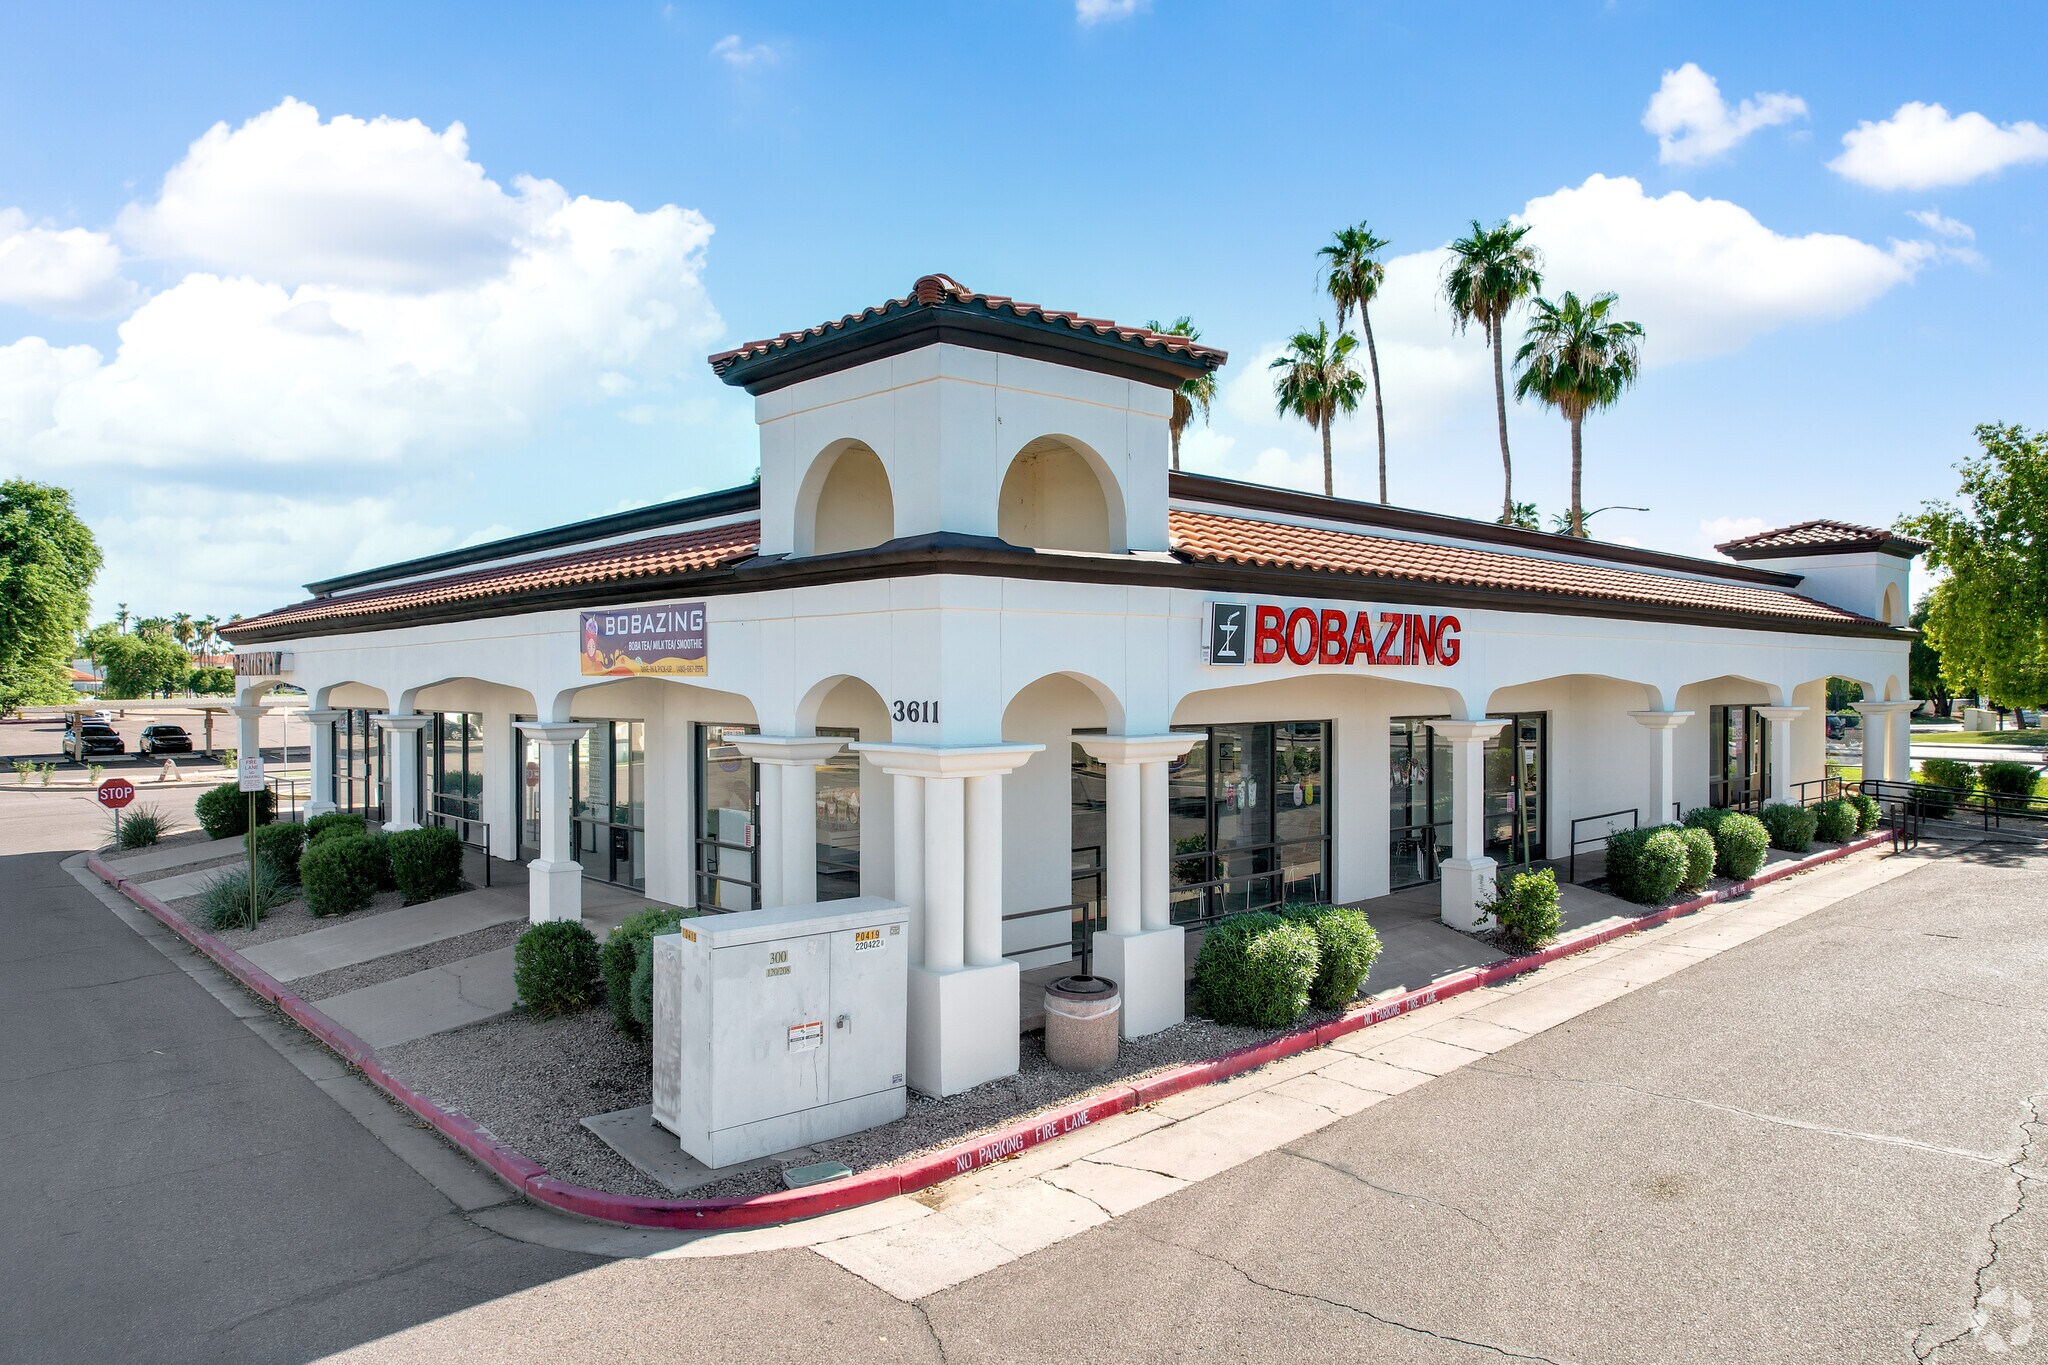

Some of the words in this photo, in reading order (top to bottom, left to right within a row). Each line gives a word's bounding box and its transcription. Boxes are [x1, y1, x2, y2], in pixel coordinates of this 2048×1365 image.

[605, 610, 703, 636] BOBAZING
[628, 641, 640, 651] BOBA
[653, 640, 664, 650] MILK
[677, 638, 703, 650] SMOOTHIE
[1254, 604, 1461, 666] BOBAZING
[892, 700, 939, 723] 3611
[100, 787, 132, 800] STOP
[855, 929, 880, 942] P0419
[855, 940, 881, 951] 220422
[769, 950, 787, 965] 300
[1363, 1012, 1373, 1026] NO
[1376, 1003, 1401, 1021] PARKING
[1406, 996, 1420, 1011] FIRE
[1421, 991, 1437, 1005] LANE
[956, 1152, 973, 1173] NO
[979, 1134, 1024, 1165] PARKING
[1035, 1121, 1059, 1143] FIRE
[1064, 1109, 1091, 1132] LANE
